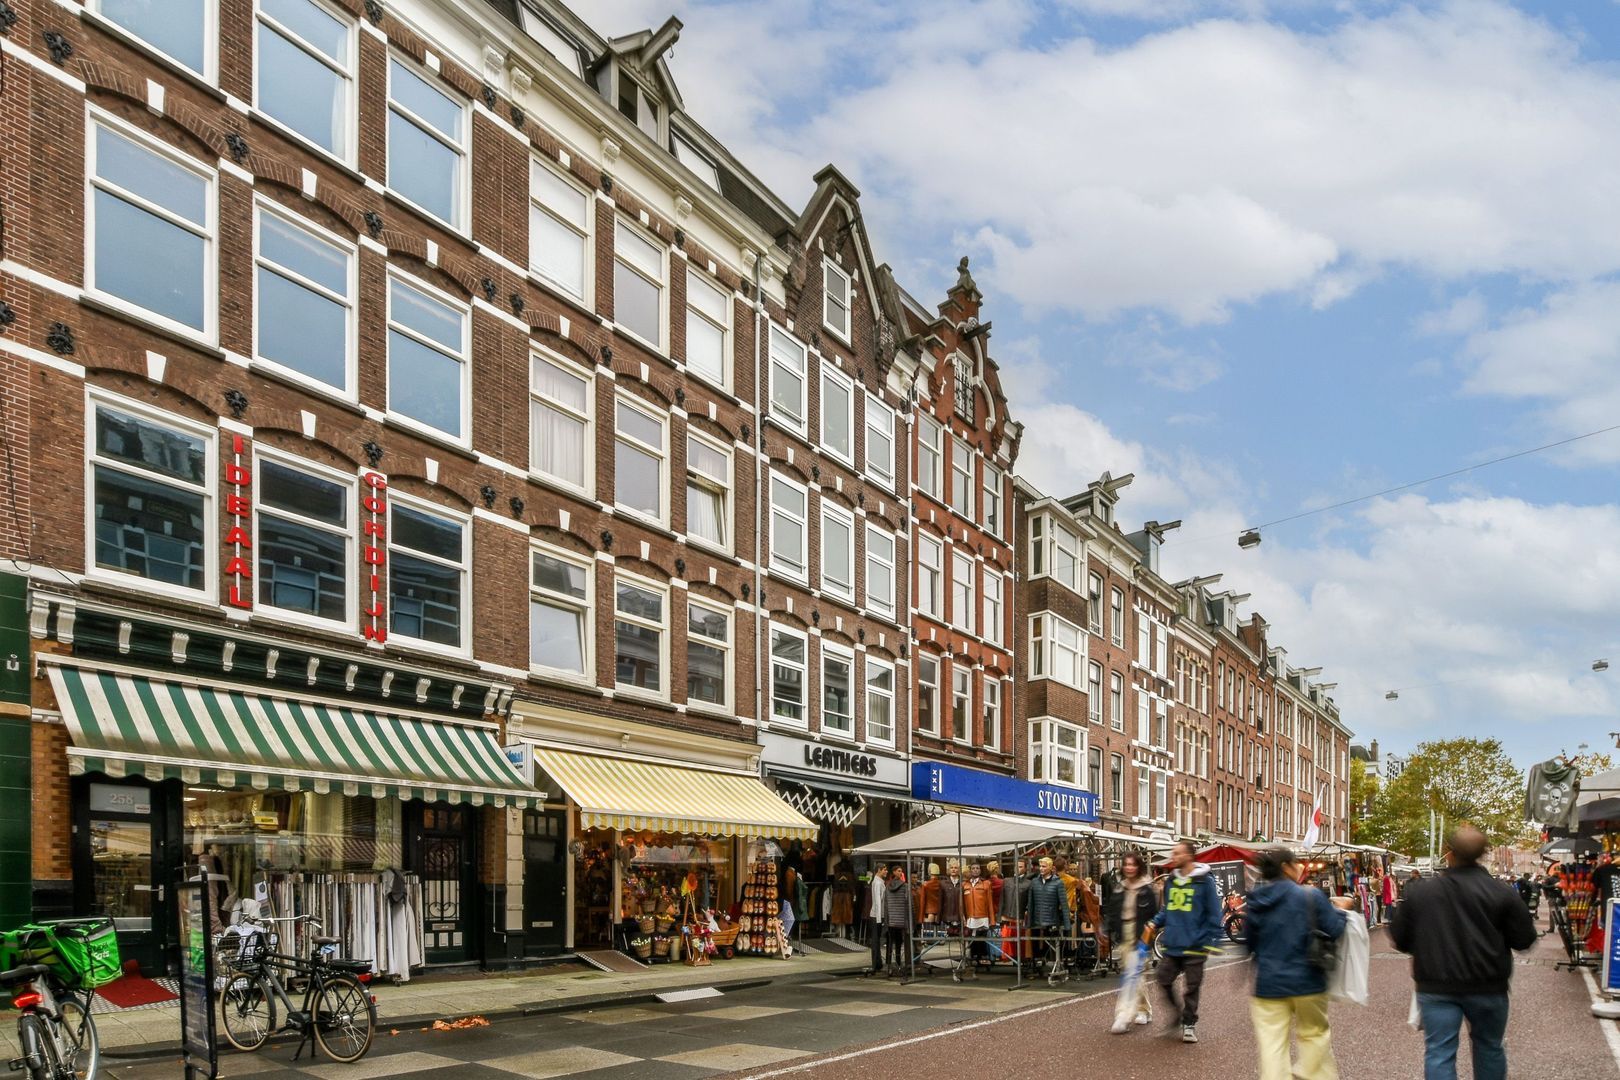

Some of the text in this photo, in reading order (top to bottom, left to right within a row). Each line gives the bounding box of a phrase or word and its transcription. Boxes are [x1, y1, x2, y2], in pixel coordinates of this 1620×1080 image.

[224, 434, 252, 608] IDEAAL
[364, 472, 388, 643] GORDIJN
[804, 744, 877, 777] LEATHERS
[110, 792, 134, 805] 258
[1038, 789, 1088, 815] STOFFEN
